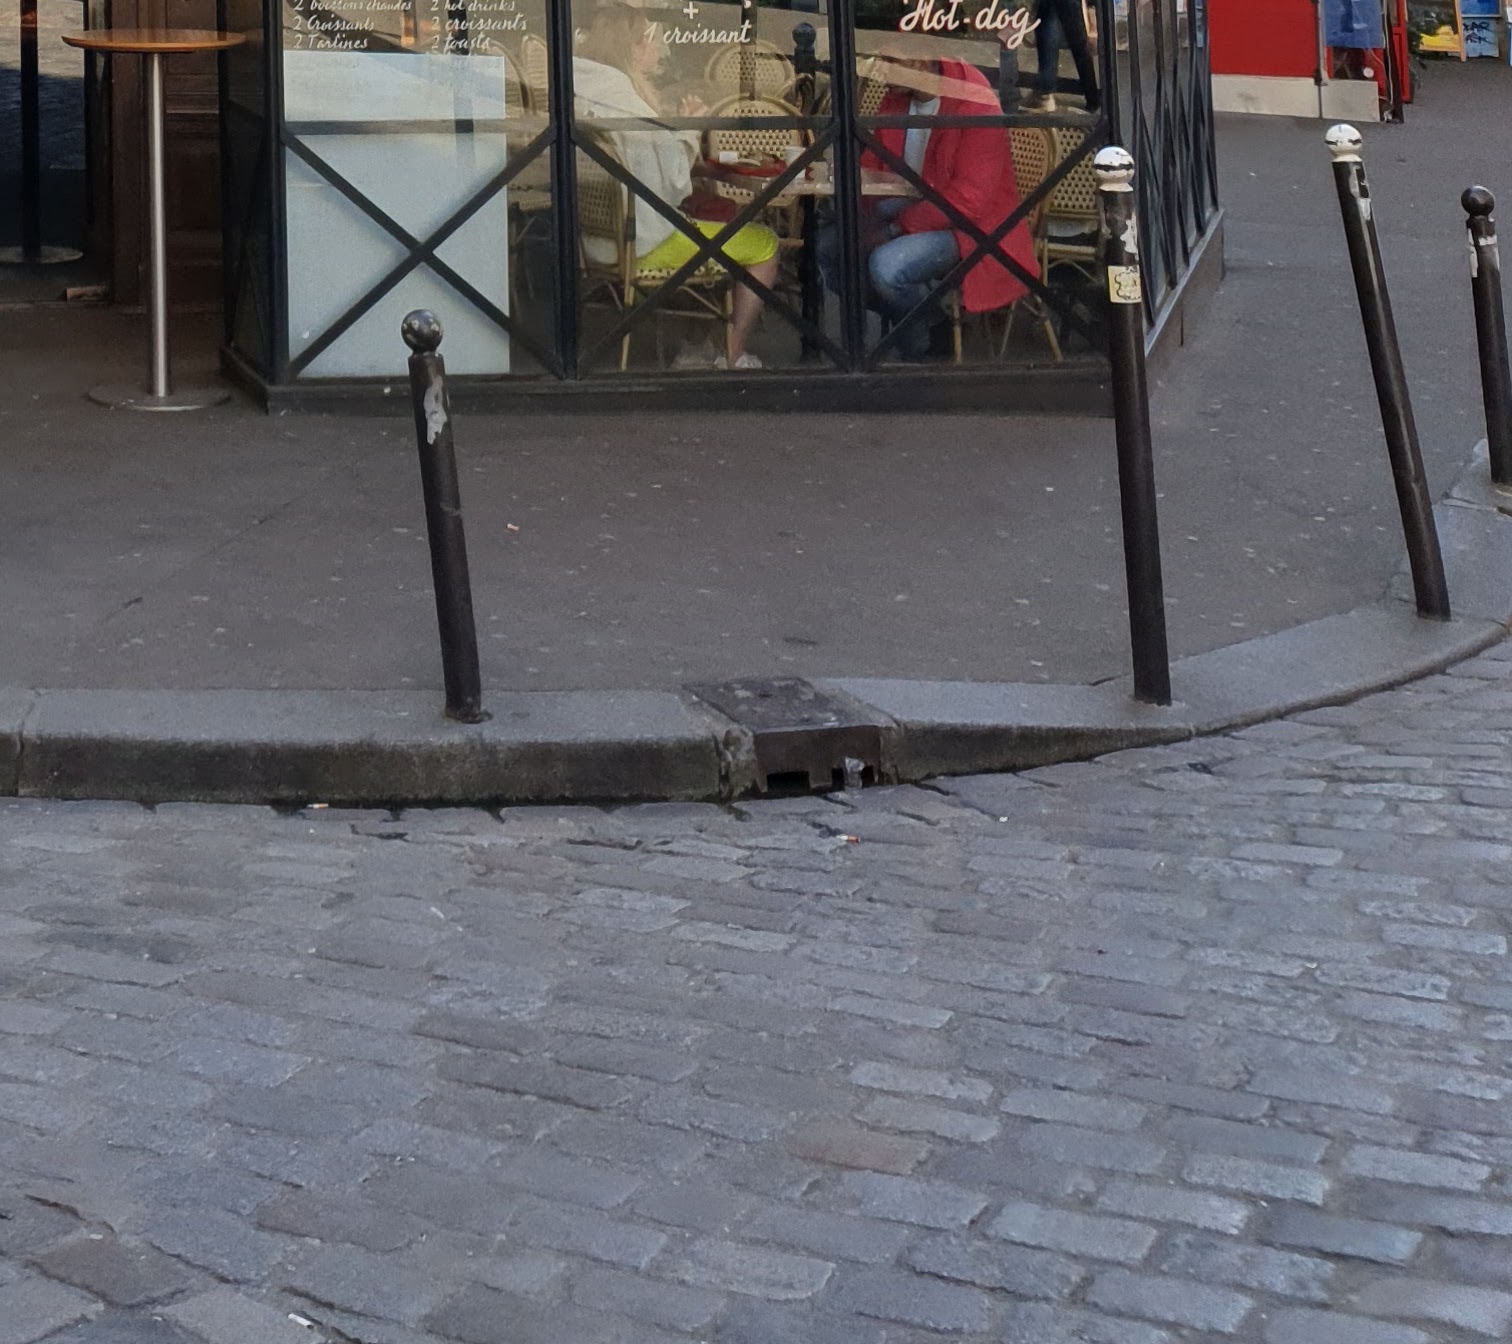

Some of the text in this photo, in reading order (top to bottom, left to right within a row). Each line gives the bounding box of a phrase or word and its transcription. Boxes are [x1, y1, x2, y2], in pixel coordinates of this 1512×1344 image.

[465, 0, 516, 12] drinks
[293, 16, 302, 32] 2
[444, 13, 528, 31] croissants
[663, 19, 753, 45] croissant
[293, 35, 368, 50] 2 Tartines
